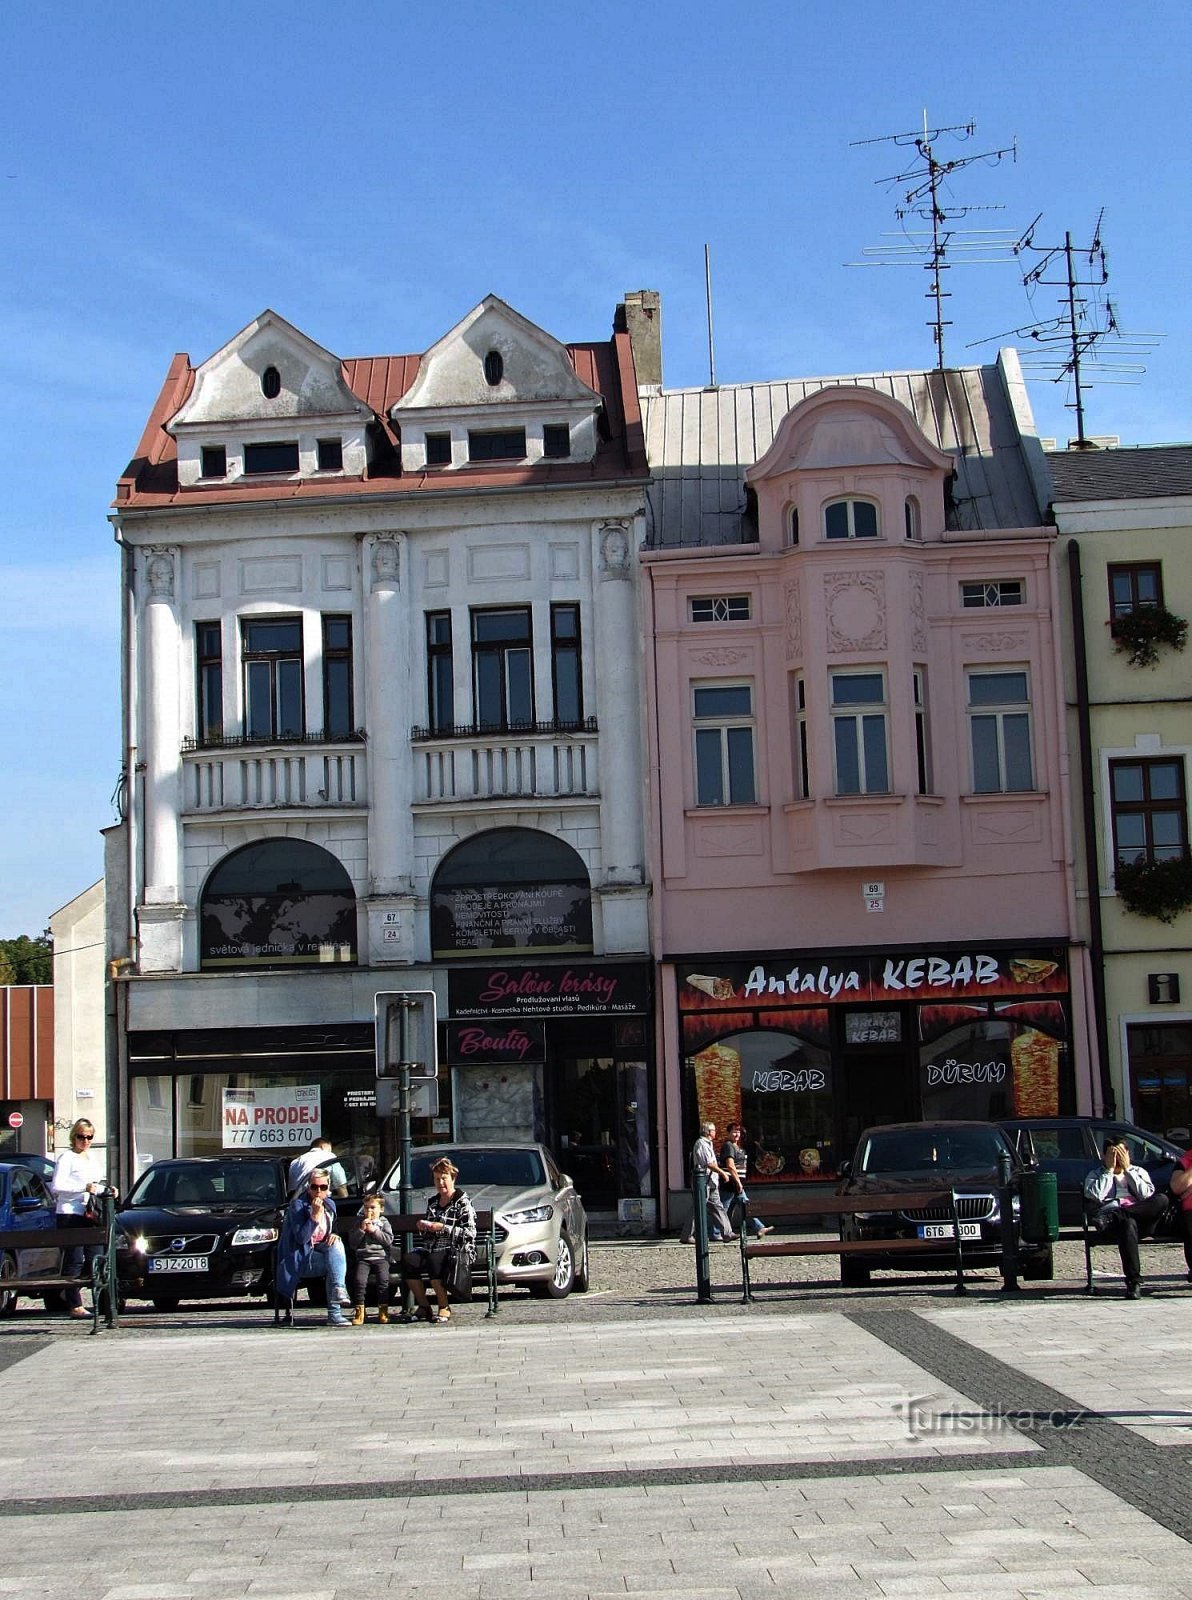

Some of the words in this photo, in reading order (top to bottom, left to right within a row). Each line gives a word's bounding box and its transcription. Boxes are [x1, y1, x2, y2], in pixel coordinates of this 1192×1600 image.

[869, 884, 879, 893] 69
[870, 900, 880, 908] 25
[387, 913, 396, 921] 67
[494, 919, 500, 927] A
[387, 930, 397, 938] 24
[534, 926, 541, 934] V
[542, 925, 575, 933] OBLASTI
[252, 941, 295, 955] jednička
[299, 943, 305, 951] v
[745, 965, 860, 998] Antalya
[882, 955, 1000, 990] KEBAB
[479, 971, 554, 1001] Salón
[559, 970, 617, 1003] krásy
[491, 1006, 521, 1014] Kosmetika
[522, 1004, 550, 1013] Nehtové
[552, 1004, 574, 1012] studio
[611, 1001, 637, 1010] Masáže
[851, 1029, 898, 1042] KEBAB
[458, 1028, 535, 1060] Boutiq
[927, 1059, 1006, 1085] DÜRUM
[752, 1069, 826, 1093] KEBAB
[225, 1108, 249, 1126] NA
[254, 1106, 319, 1125] PRODEJ
[231, 1129, 256, 1143] 777
[259, 1129, 284, 1142] 663
[288, 1127, 313, 1142] 670
[925, 1226, 945, 1237] 6T6
[154, 1259, 178, 1271] SJZ
